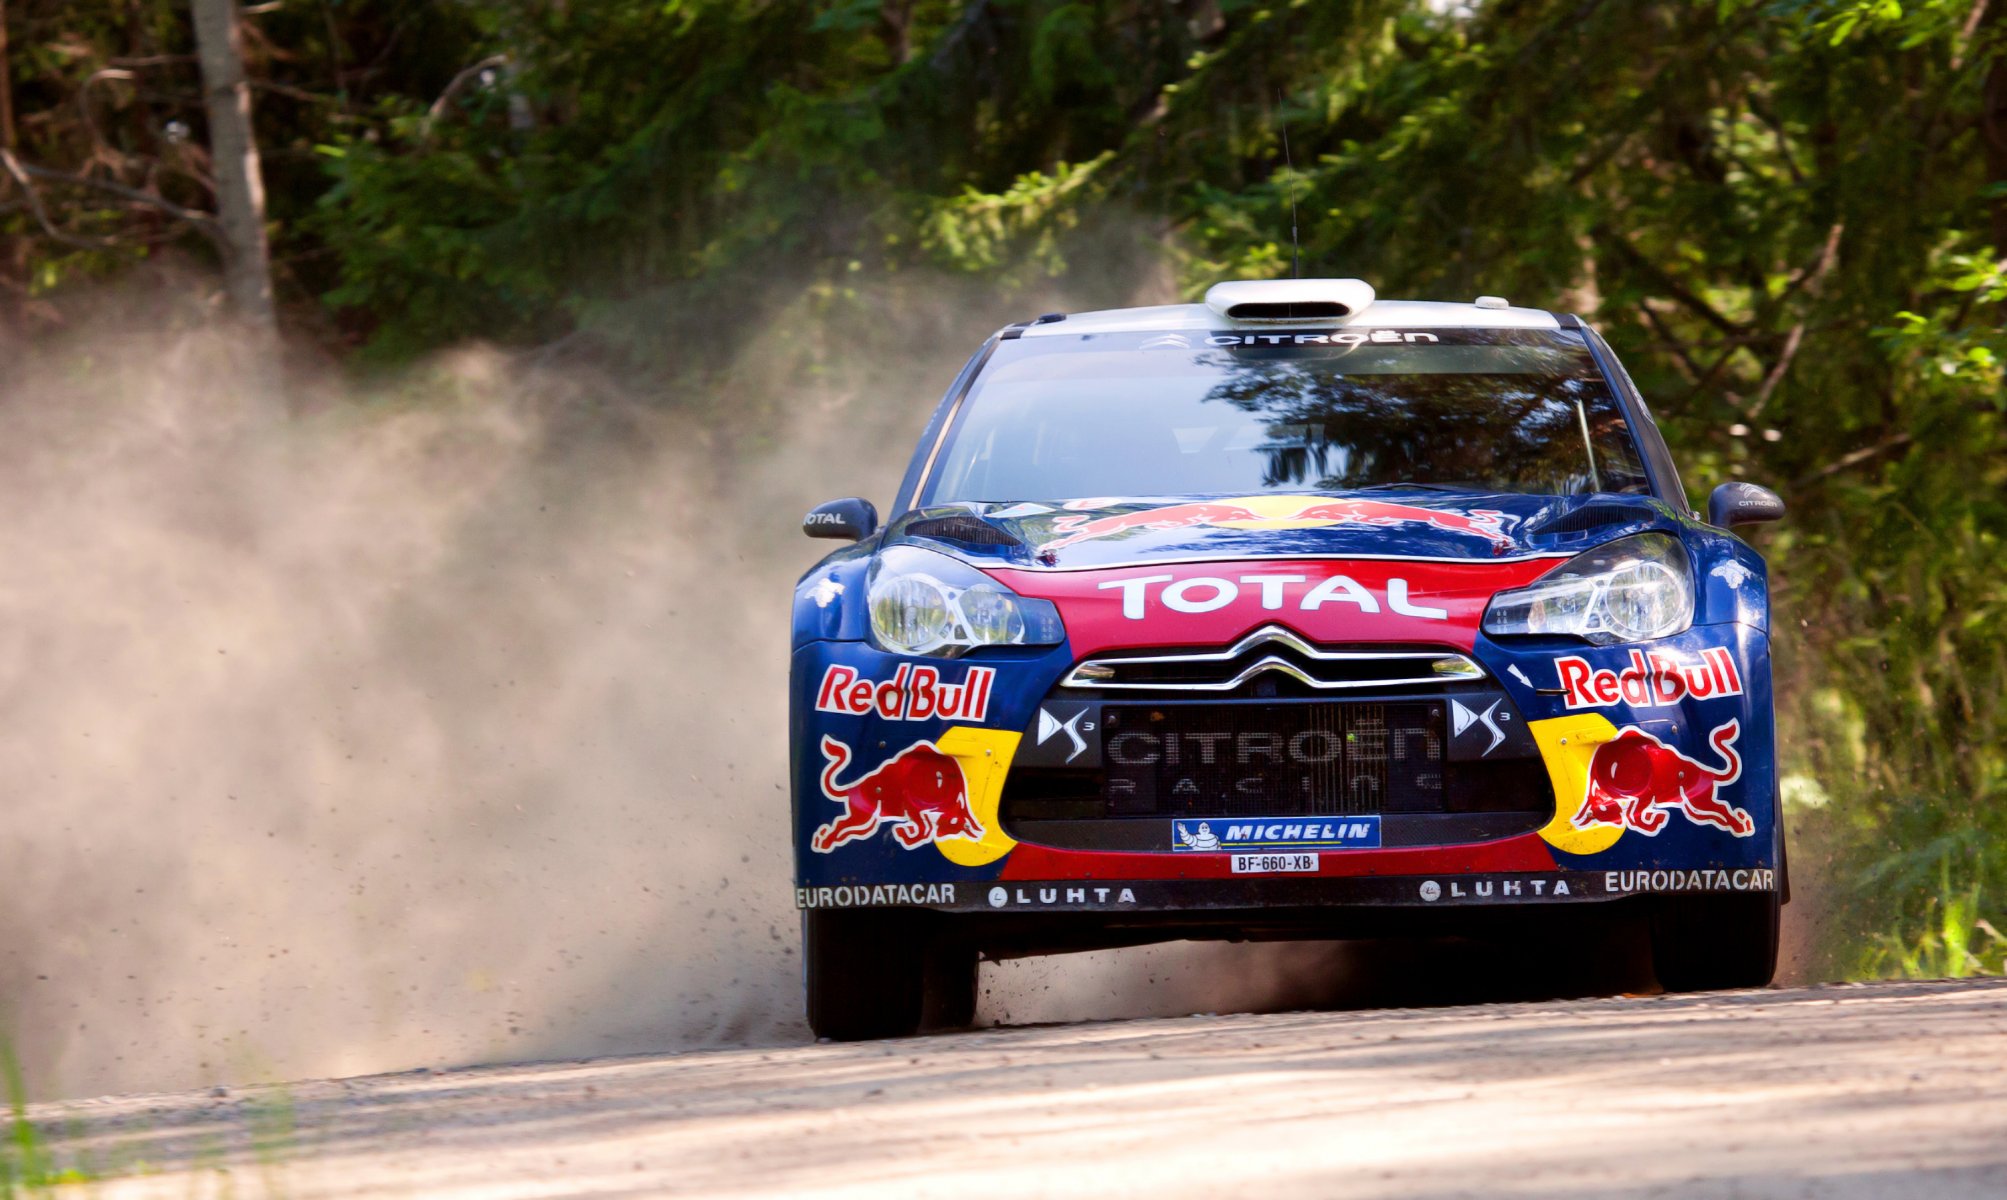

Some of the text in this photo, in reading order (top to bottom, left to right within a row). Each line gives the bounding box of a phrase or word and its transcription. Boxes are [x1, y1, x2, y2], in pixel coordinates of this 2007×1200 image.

[1098, 574, 1448, 620] TOTAL
[1225, 823, 1370, 840] MICHELIN
[1238, 855, 1311, 871] BF-660-XB
[1451, 880, 1571, 897] LUHTA
[1605, 869, 1774, 892] EURODATACAR
[797, 883, 955, 908] EURODATACAR
[1016, 887, 1137, 903] LUHTA
